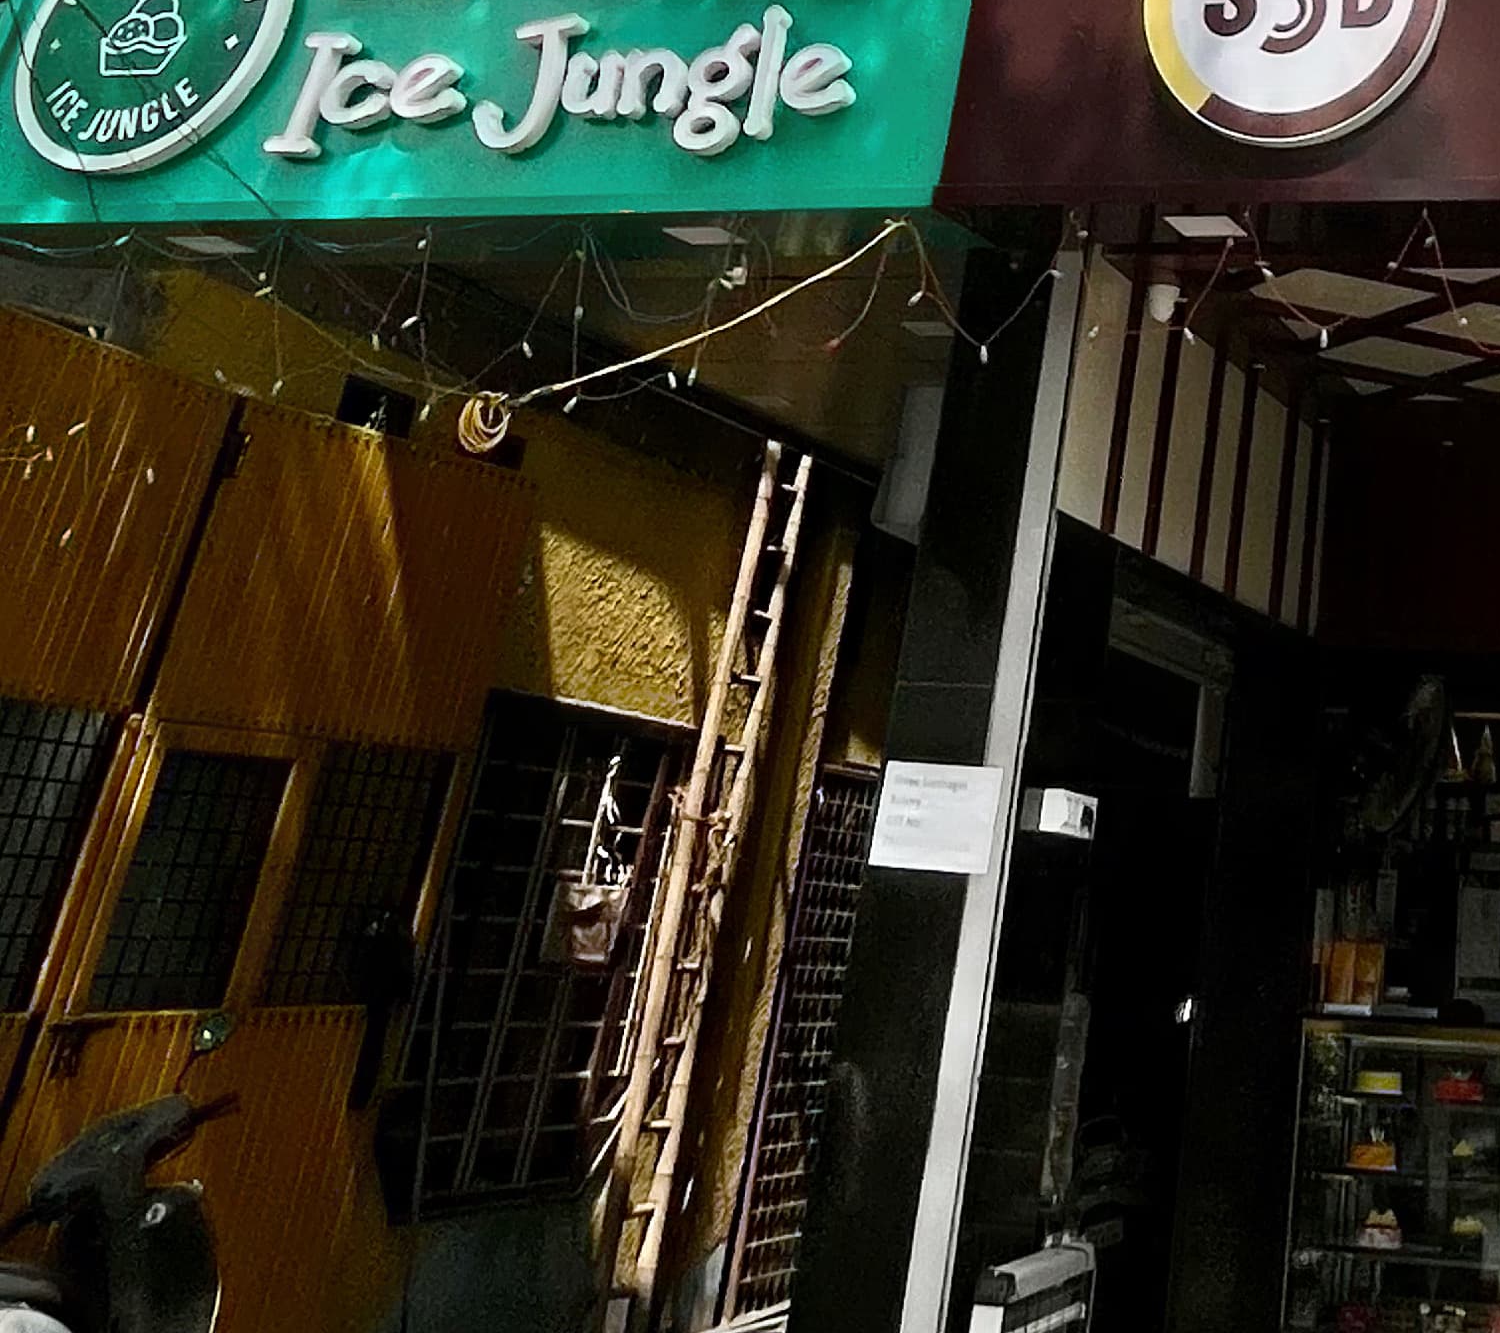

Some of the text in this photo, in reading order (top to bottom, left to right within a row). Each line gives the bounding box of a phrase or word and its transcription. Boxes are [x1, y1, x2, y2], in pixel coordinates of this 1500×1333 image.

[46, 76, 200, 143] ICE JUNGLE
[263, 5, 857, 160] Ice Jungle
